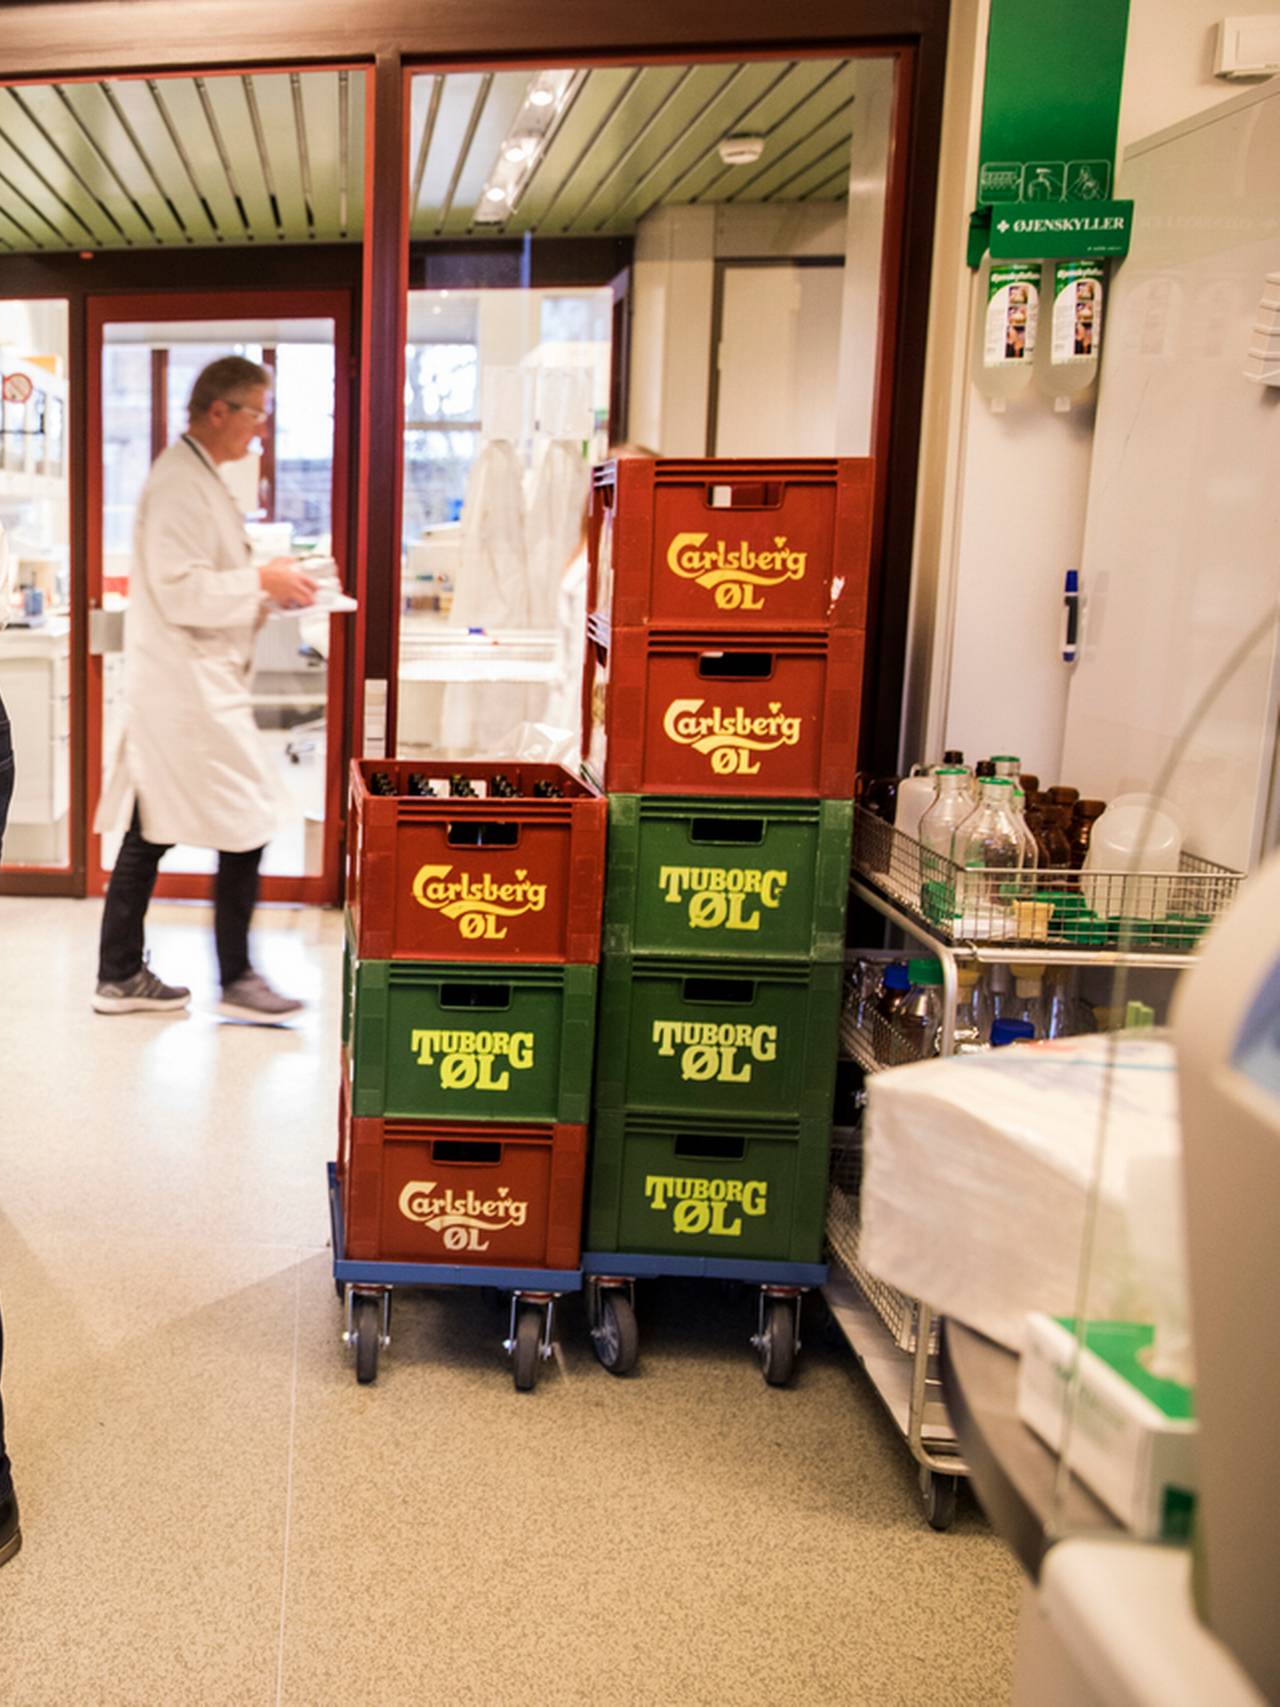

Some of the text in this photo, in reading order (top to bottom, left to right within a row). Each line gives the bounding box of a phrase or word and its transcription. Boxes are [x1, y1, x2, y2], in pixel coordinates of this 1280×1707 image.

[1013, 217, 1124, 232] ØJENSKYLLER
[667, 532, 808, 580] Carlsberg
[714, 582, 765, 610] ØL
[663, 698, 802, 745] Carlsberg
[711, 747, 761, 774] ØL
[412, 864, 547, 911] Carlsberg
[659, 866, 787, 908] TUBORG
[458, 912, 508, 939] ØL
[688, 891, 760, 930] ØL
[411, 1029, 534, 1069] TUBORG
[652, 1020, 777, 1061] TUBORG
[440, 1054, 509, 1091] ØL
[681, 1045, 751, 1082] ØL
[399, 1181, 528, 1226] Carlsberg
[645, 1175, 768, 1216] TUBORG
[673, 1199, 741, 1236] ØL
[443, 1227, 489, 1251] ØL
